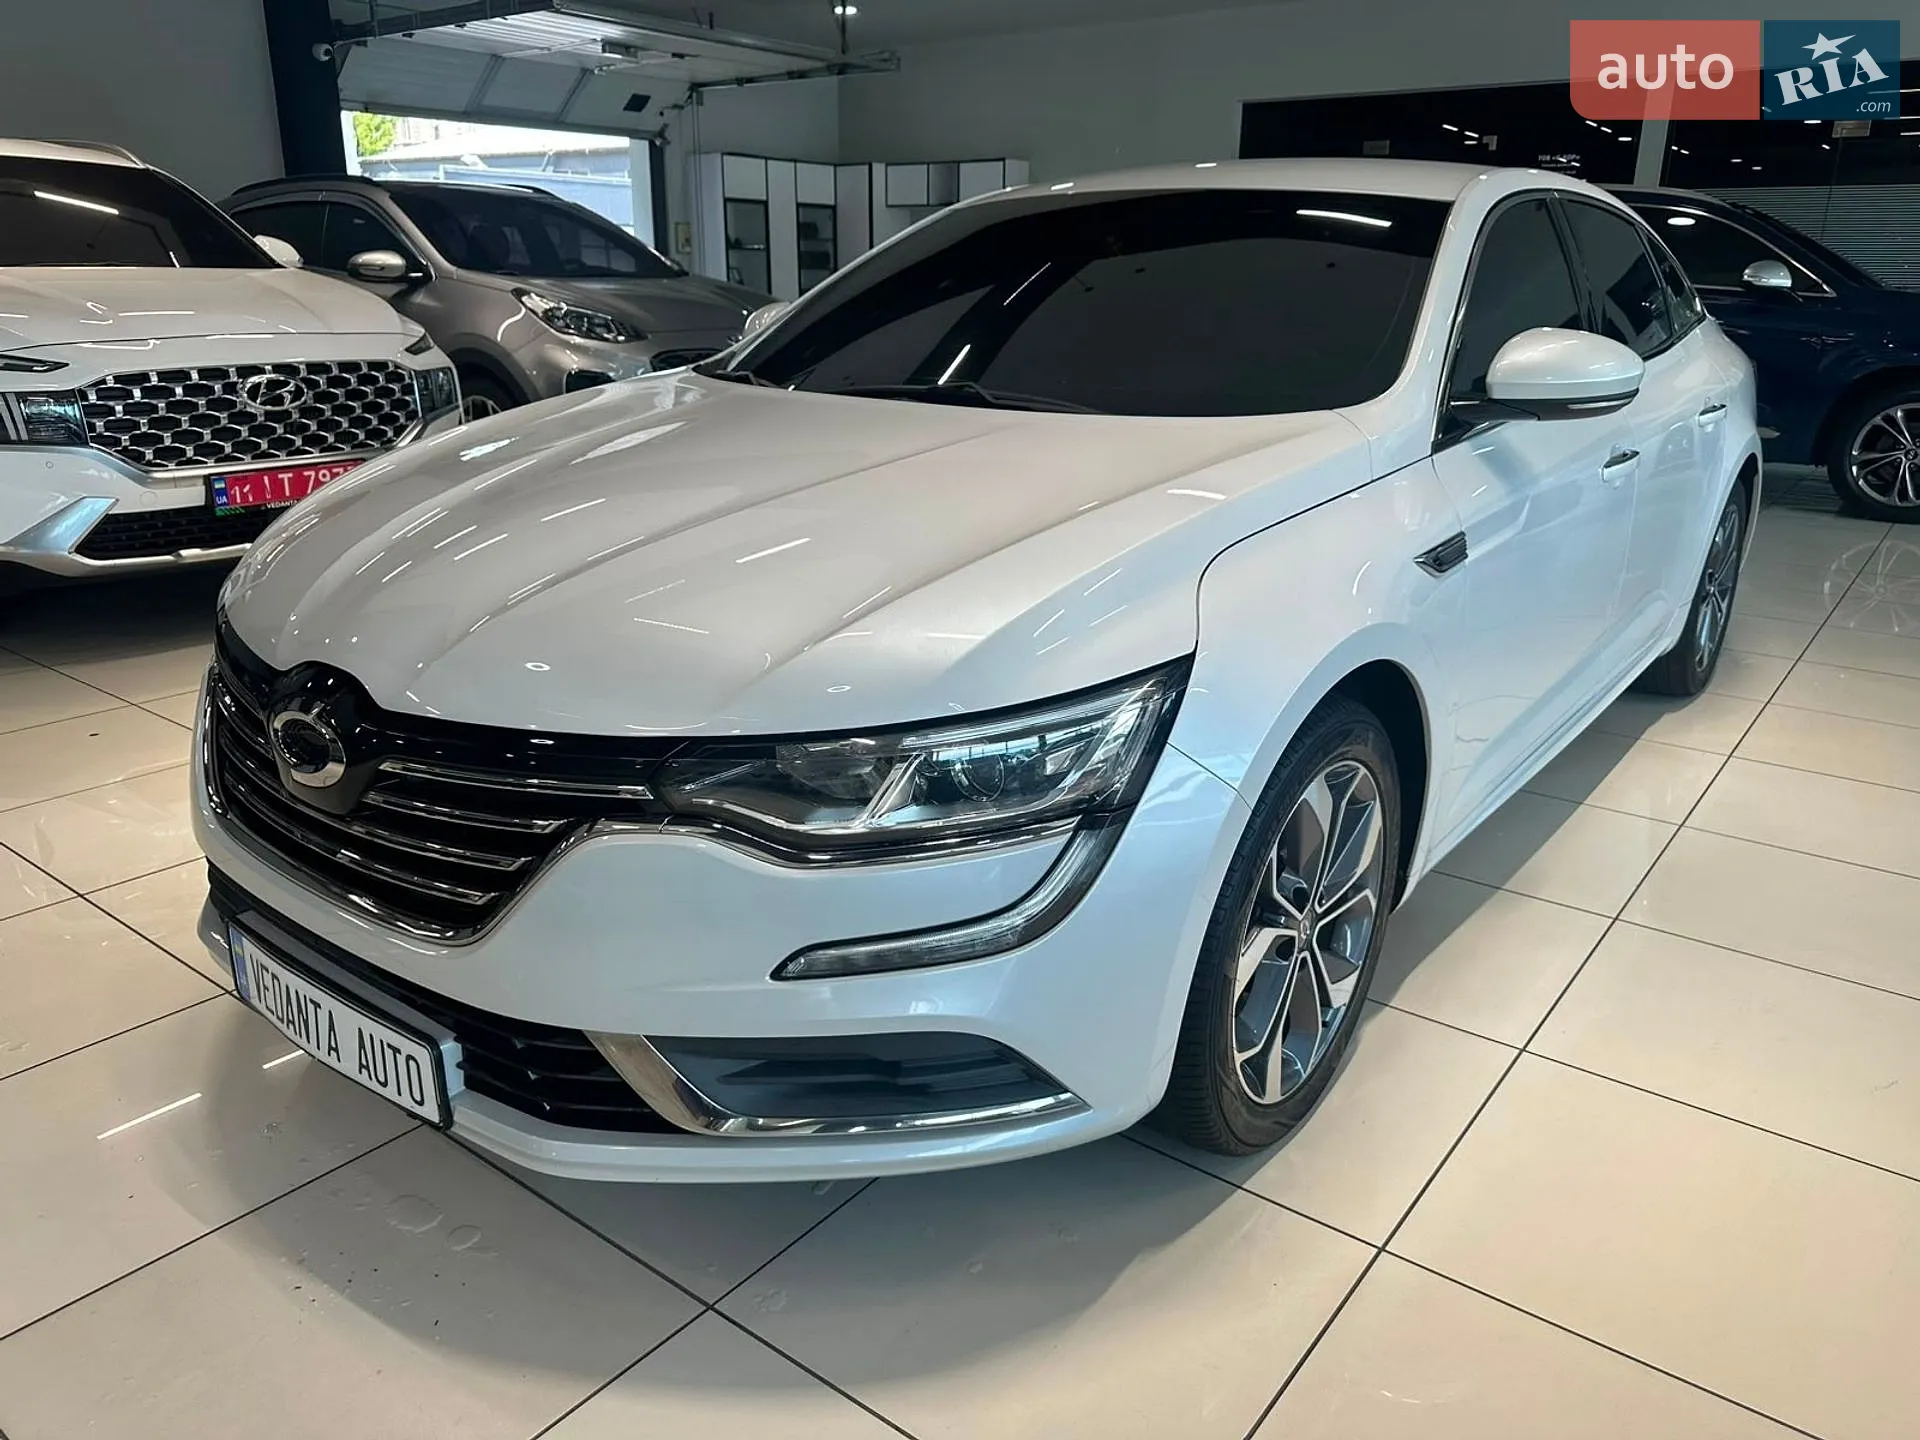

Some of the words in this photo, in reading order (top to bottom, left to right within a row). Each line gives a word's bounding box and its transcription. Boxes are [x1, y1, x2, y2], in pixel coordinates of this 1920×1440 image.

[216, 495, 228, 505] UA
[249, 952, 341, 1064] VEDANTA
[357, 1026, 425, 1108] AUTO
